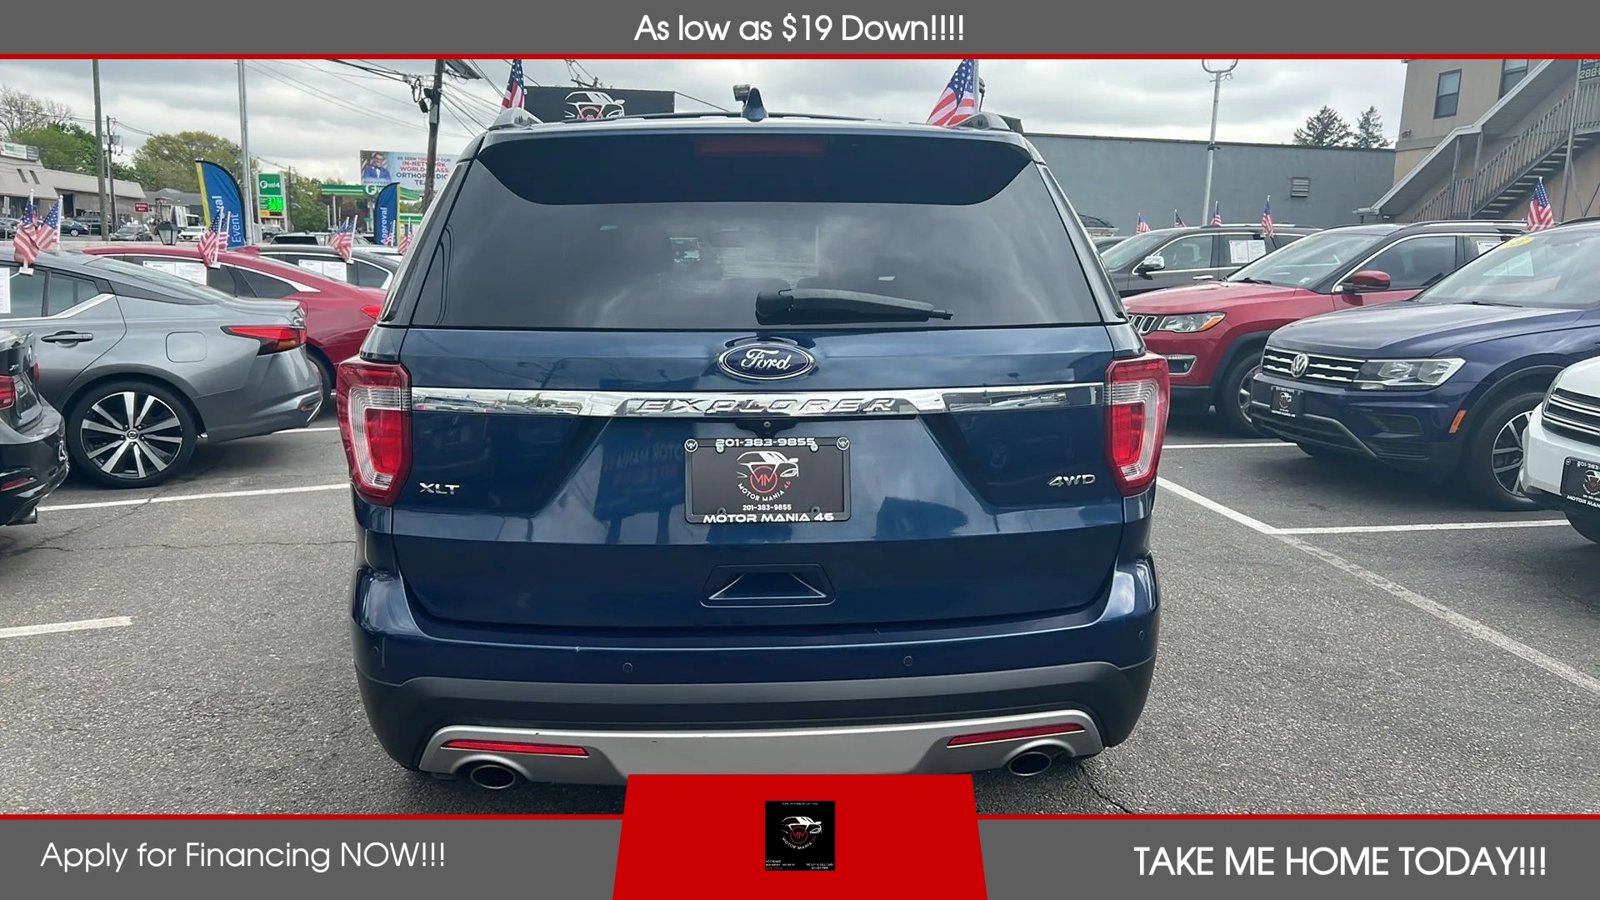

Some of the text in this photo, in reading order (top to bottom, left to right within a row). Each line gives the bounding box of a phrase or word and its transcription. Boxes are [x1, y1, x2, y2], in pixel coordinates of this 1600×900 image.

[231, 213, 241, 243] Event
[740, 348, 791, 370] Ford
[635, 397, 896, 413] EXPLORER
[715, 438, 816, 447] 201-383-9855
[1049, 474, 1096, 487] 4WD
[419, 482, 460, 495] XLT
[738, 482, 761, 502] MOTOR
[762, 490, 785, 502] MANIA
[742, 503, 792, 511] 201-383-9855
[703, 512, 835, 523] MOTOR MANIA 46
